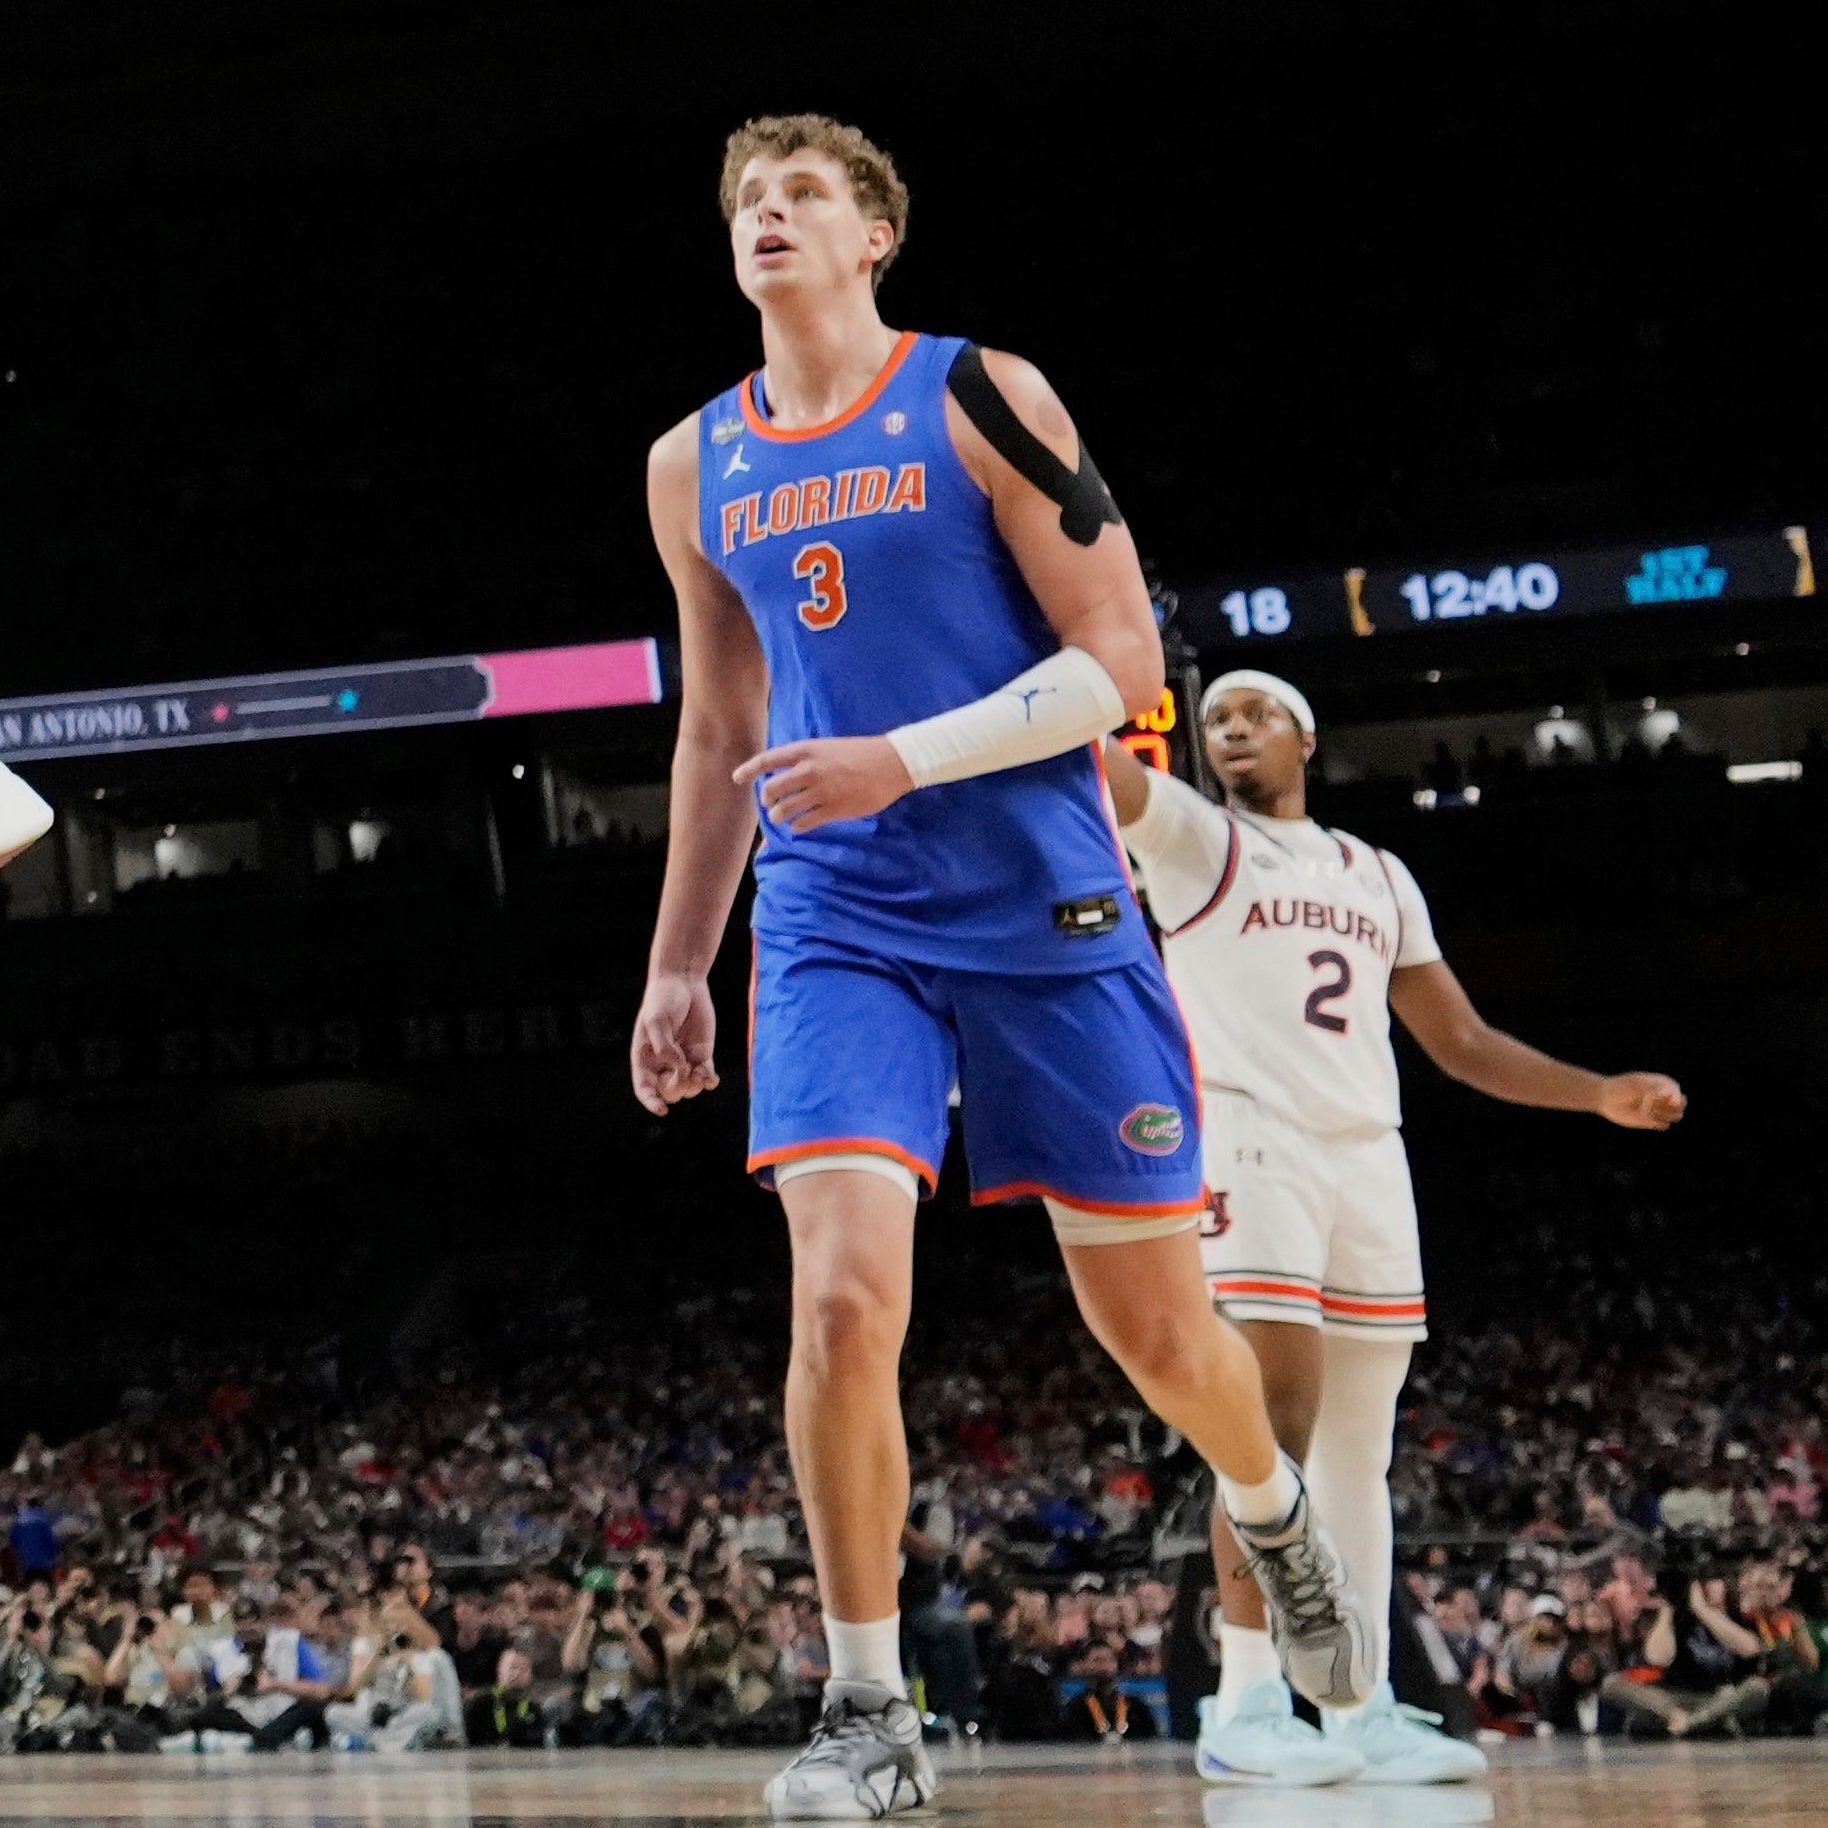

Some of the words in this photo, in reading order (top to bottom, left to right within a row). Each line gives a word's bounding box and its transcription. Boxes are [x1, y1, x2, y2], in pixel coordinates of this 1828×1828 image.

[720, 461, 926, 556] FLORIDA
[793, 541, 848, 632] 3
[1220, 587, 1291, 637] 18
[1400, 563, 1560, 622] 12:40
[154, 698, 191, 734] TX
[1305, 949, 1351, 1037] 2
